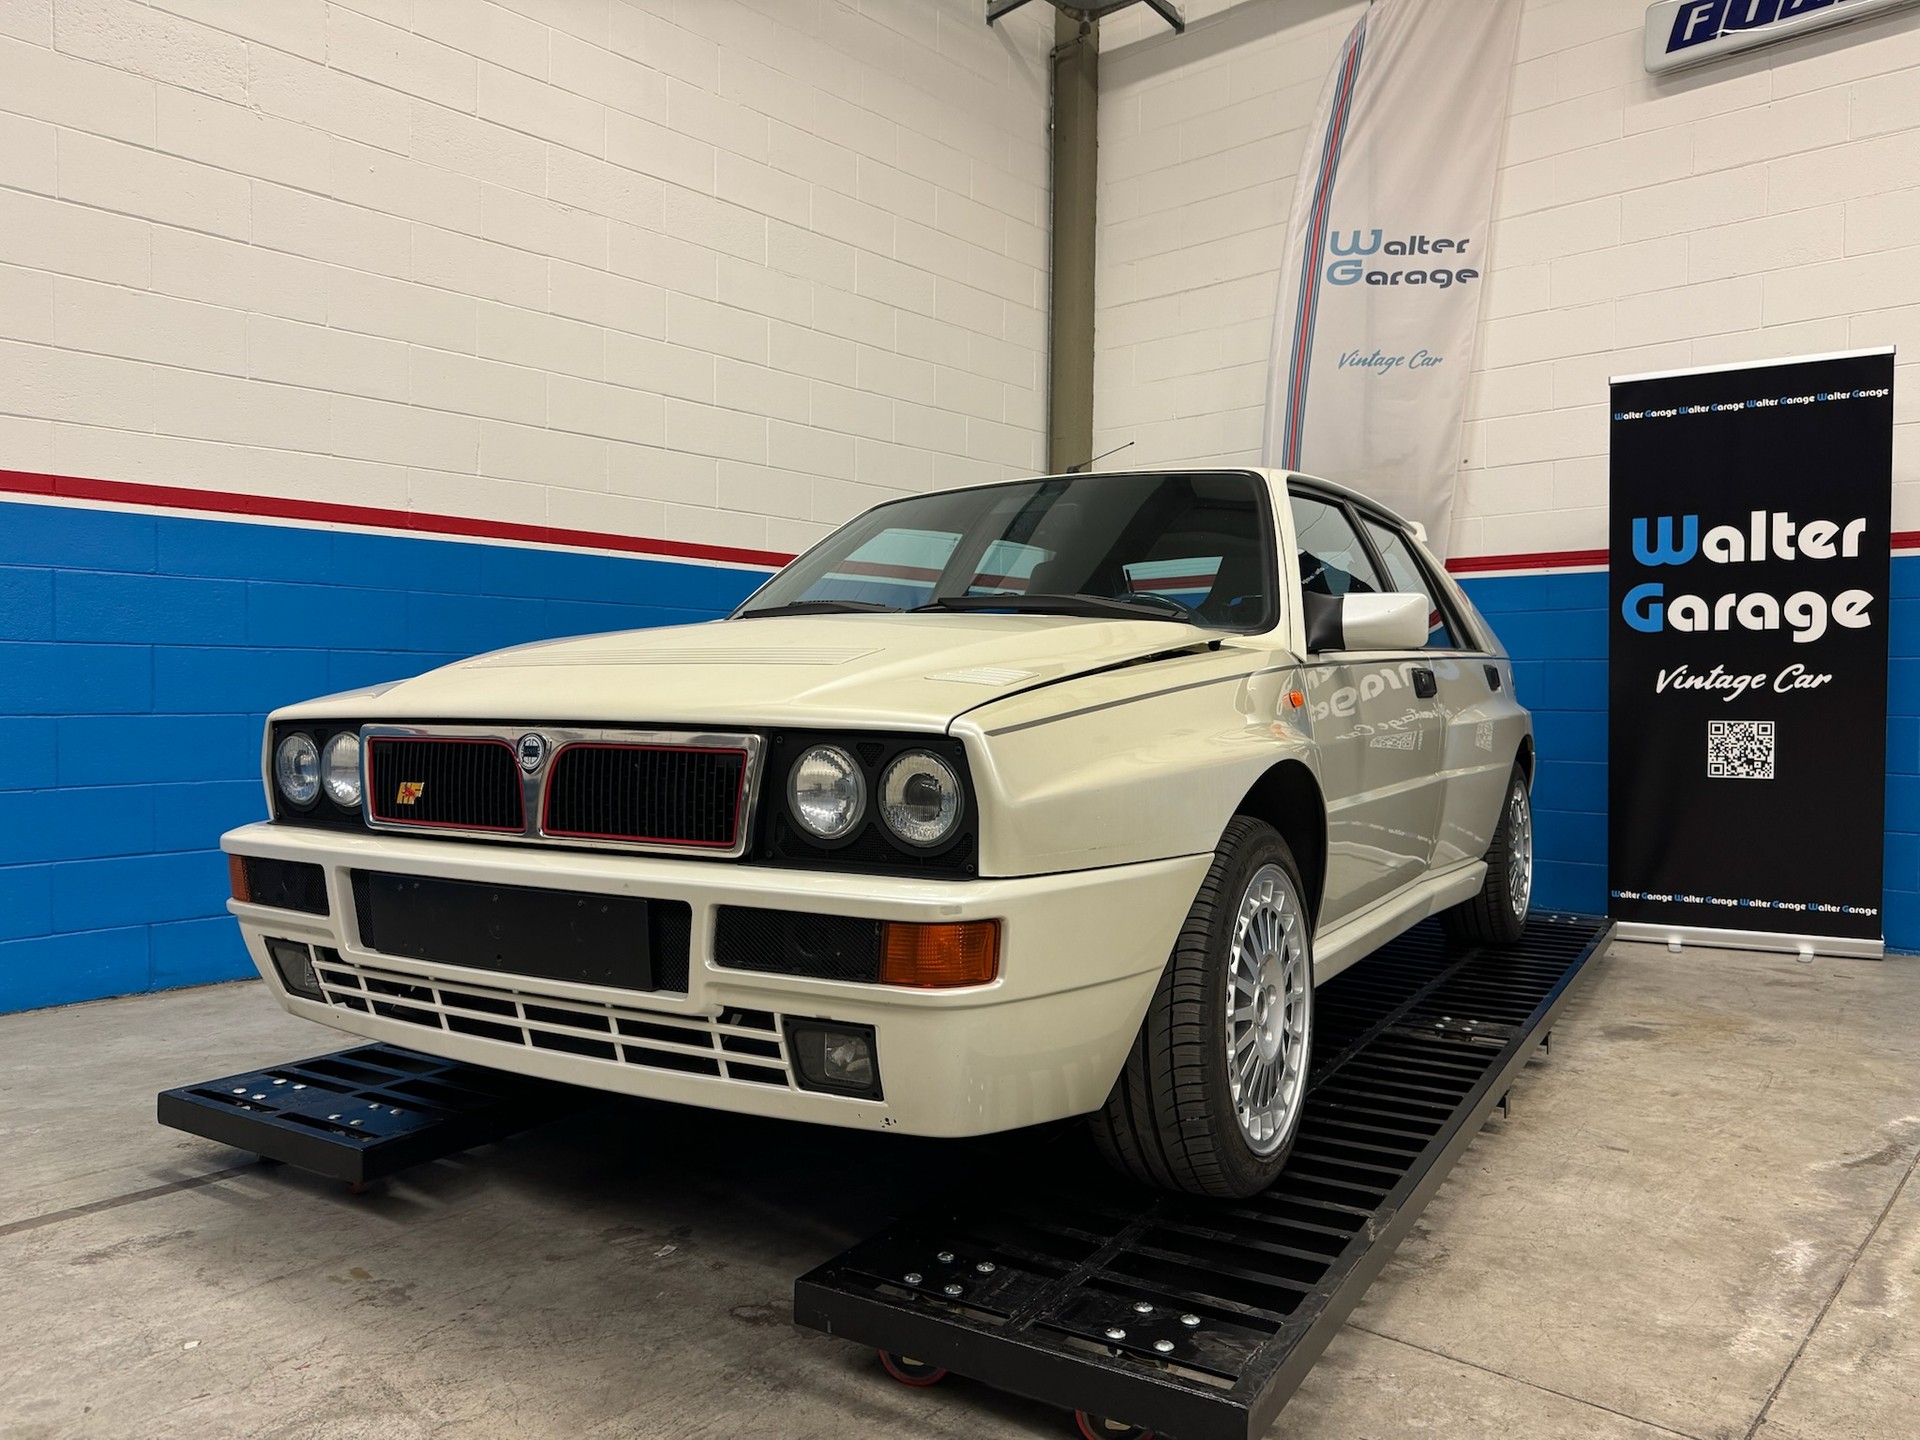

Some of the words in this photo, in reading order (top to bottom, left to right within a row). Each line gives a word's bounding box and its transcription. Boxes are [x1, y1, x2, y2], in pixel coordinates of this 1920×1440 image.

[1329, 229, 1470, 256] Walter
[1326, 259, 1479, 289] Garage
[1338, 349, 1405, 376] Vintage
[1408, 350, 1443, 368] Car
[1614, 412, 1644, 420] Walter
[1645, 408, 1677, 419] Garage
[1679, 405, 1709, 415] Walter
[1711, 402, 1744, 412] Garage
[1746, 398, 1778, 408] Walter
[1780, 394, 1815, 405] Garage
[1817, 391, 1850, 401] Walter
[1852, 388, 1889, 399] Garage
[1631, 510, 1866, 567] Walter
[1621, 582, 1874, 644] Garage
[1655, 664, 1766, 702] Vintage
[1774, 664, 1832, 694] Car
[1612, 890, 1640, 900] Walter
[1641, 892, 1673, 902] Garage
[1674, 894, 1704, 904] Walter
[1705, 896, 1738, 907] Garage
[1740, 898, 1771, 908] Walter
[1772, 900, 1806, 911] Garage
[1808, 903, 1840, 913] Walter
[1842, 905, 1878, 916] Garage
